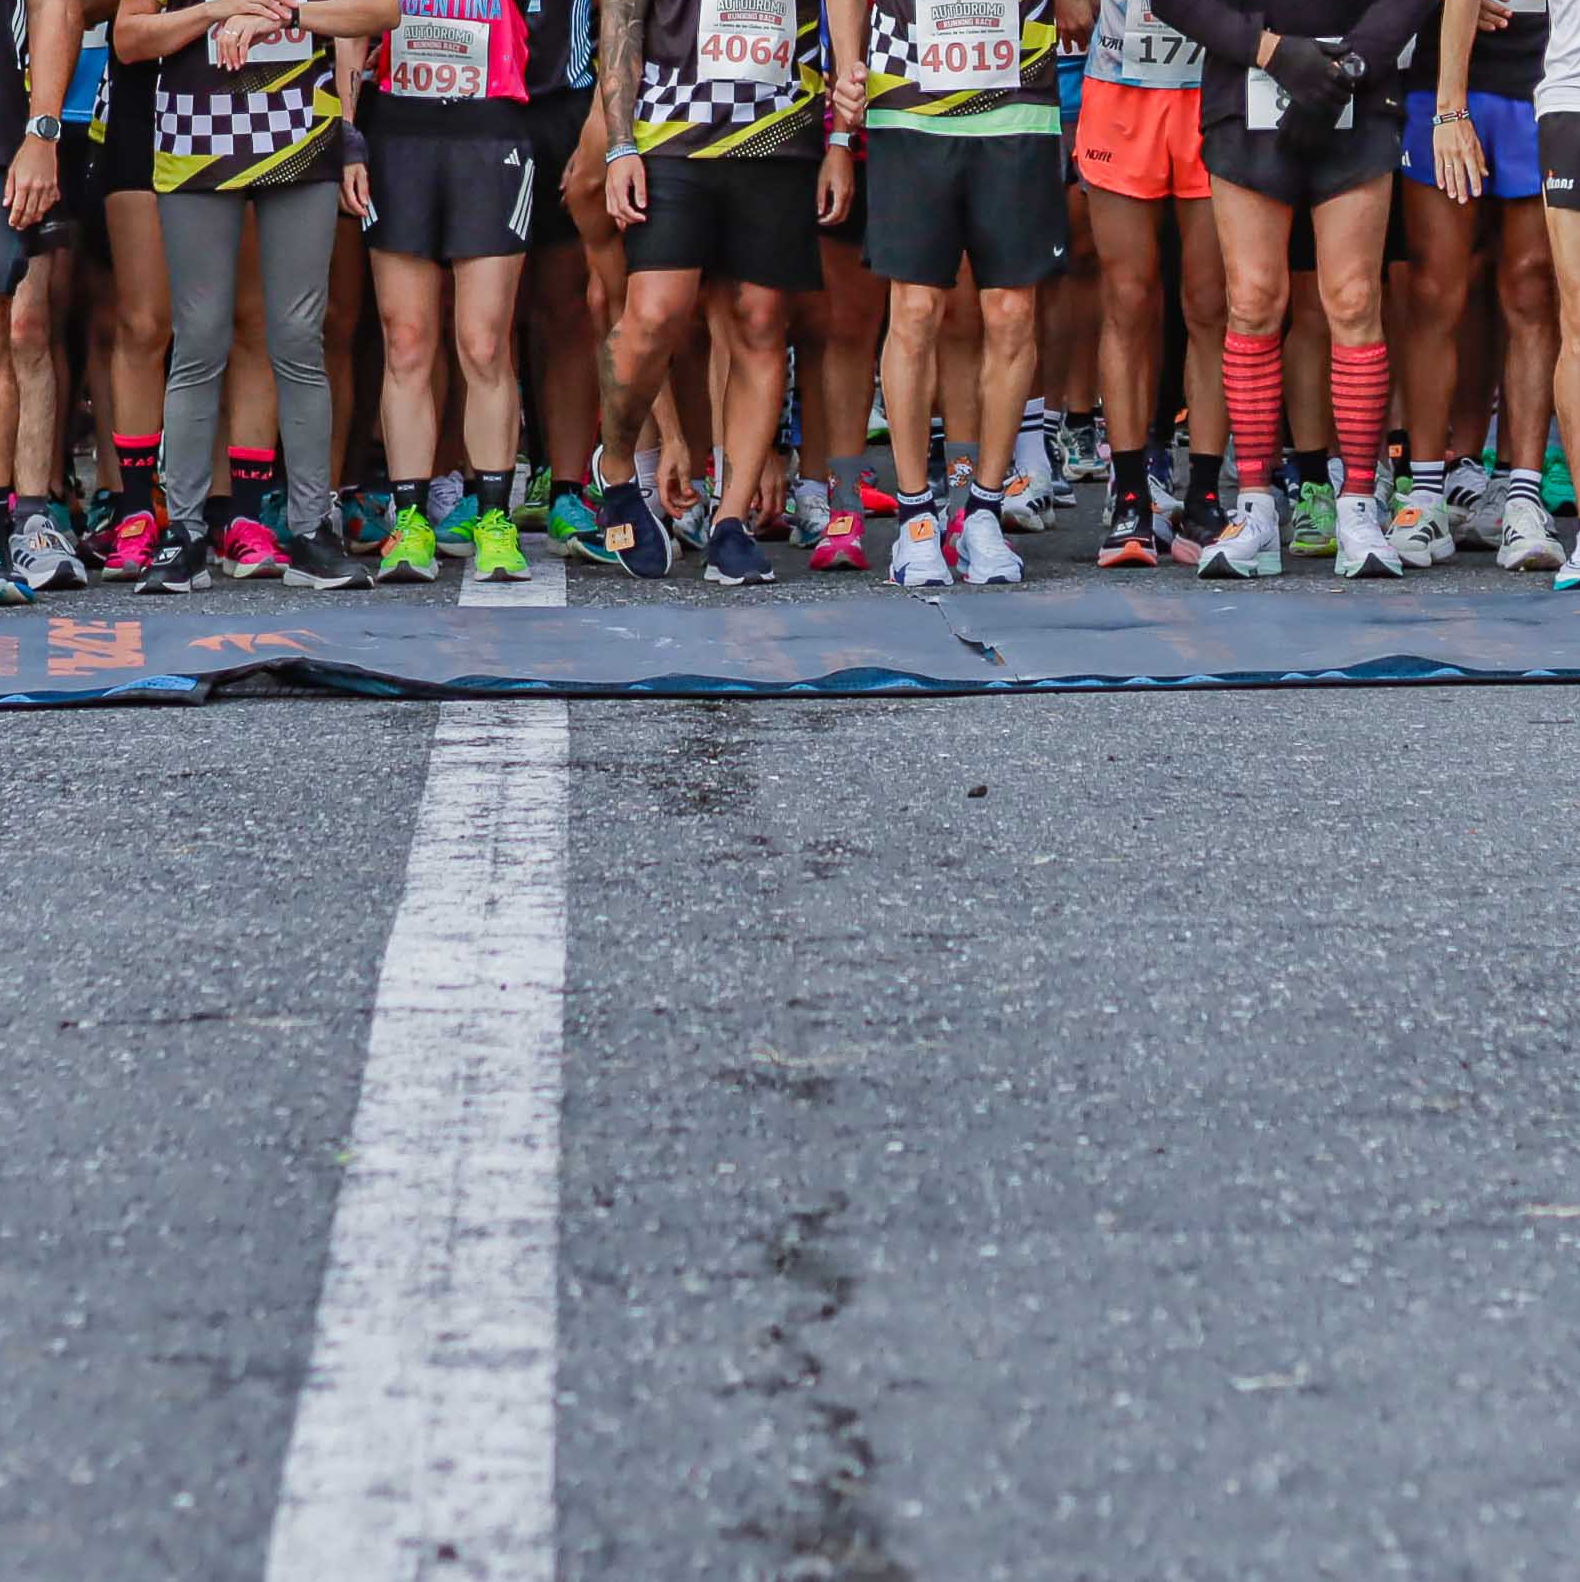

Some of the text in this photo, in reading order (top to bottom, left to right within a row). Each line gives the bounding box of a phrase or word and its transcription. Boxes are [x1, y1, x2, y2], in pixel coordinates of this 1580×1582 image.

[931, 0, 1005, 20] AUTÓDROMO
[404, 23, 474, 43] AUTÓDROMO
[701, 34, 790, 68] 4064
[921, 39, 1014, 73] 4019
[393, 62, 481, 95] 4093
